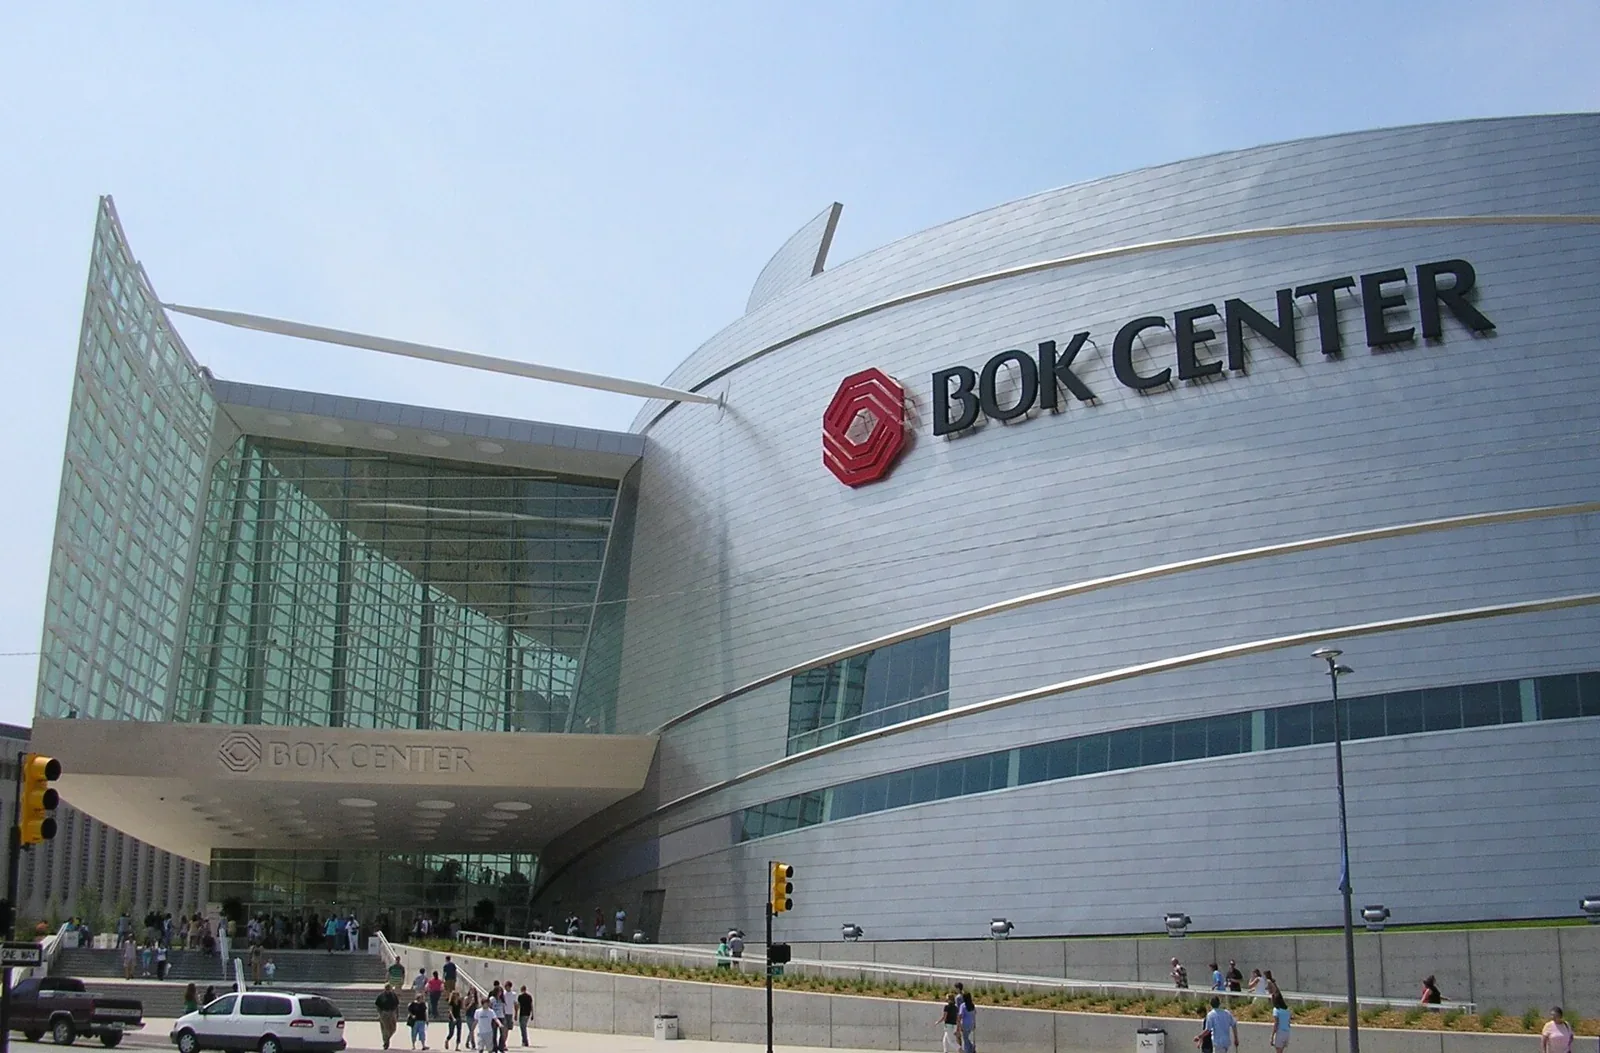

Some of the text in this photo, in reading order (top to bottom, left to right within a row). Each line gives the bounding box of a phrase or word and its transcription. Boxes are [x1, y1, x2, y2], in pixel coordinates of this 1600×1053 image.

[932, 258, 1497, 437] BOK CENTER
[269, 740, 475, 773] BOK CENTER
[2, 949, 37, 960] ONE WAY
